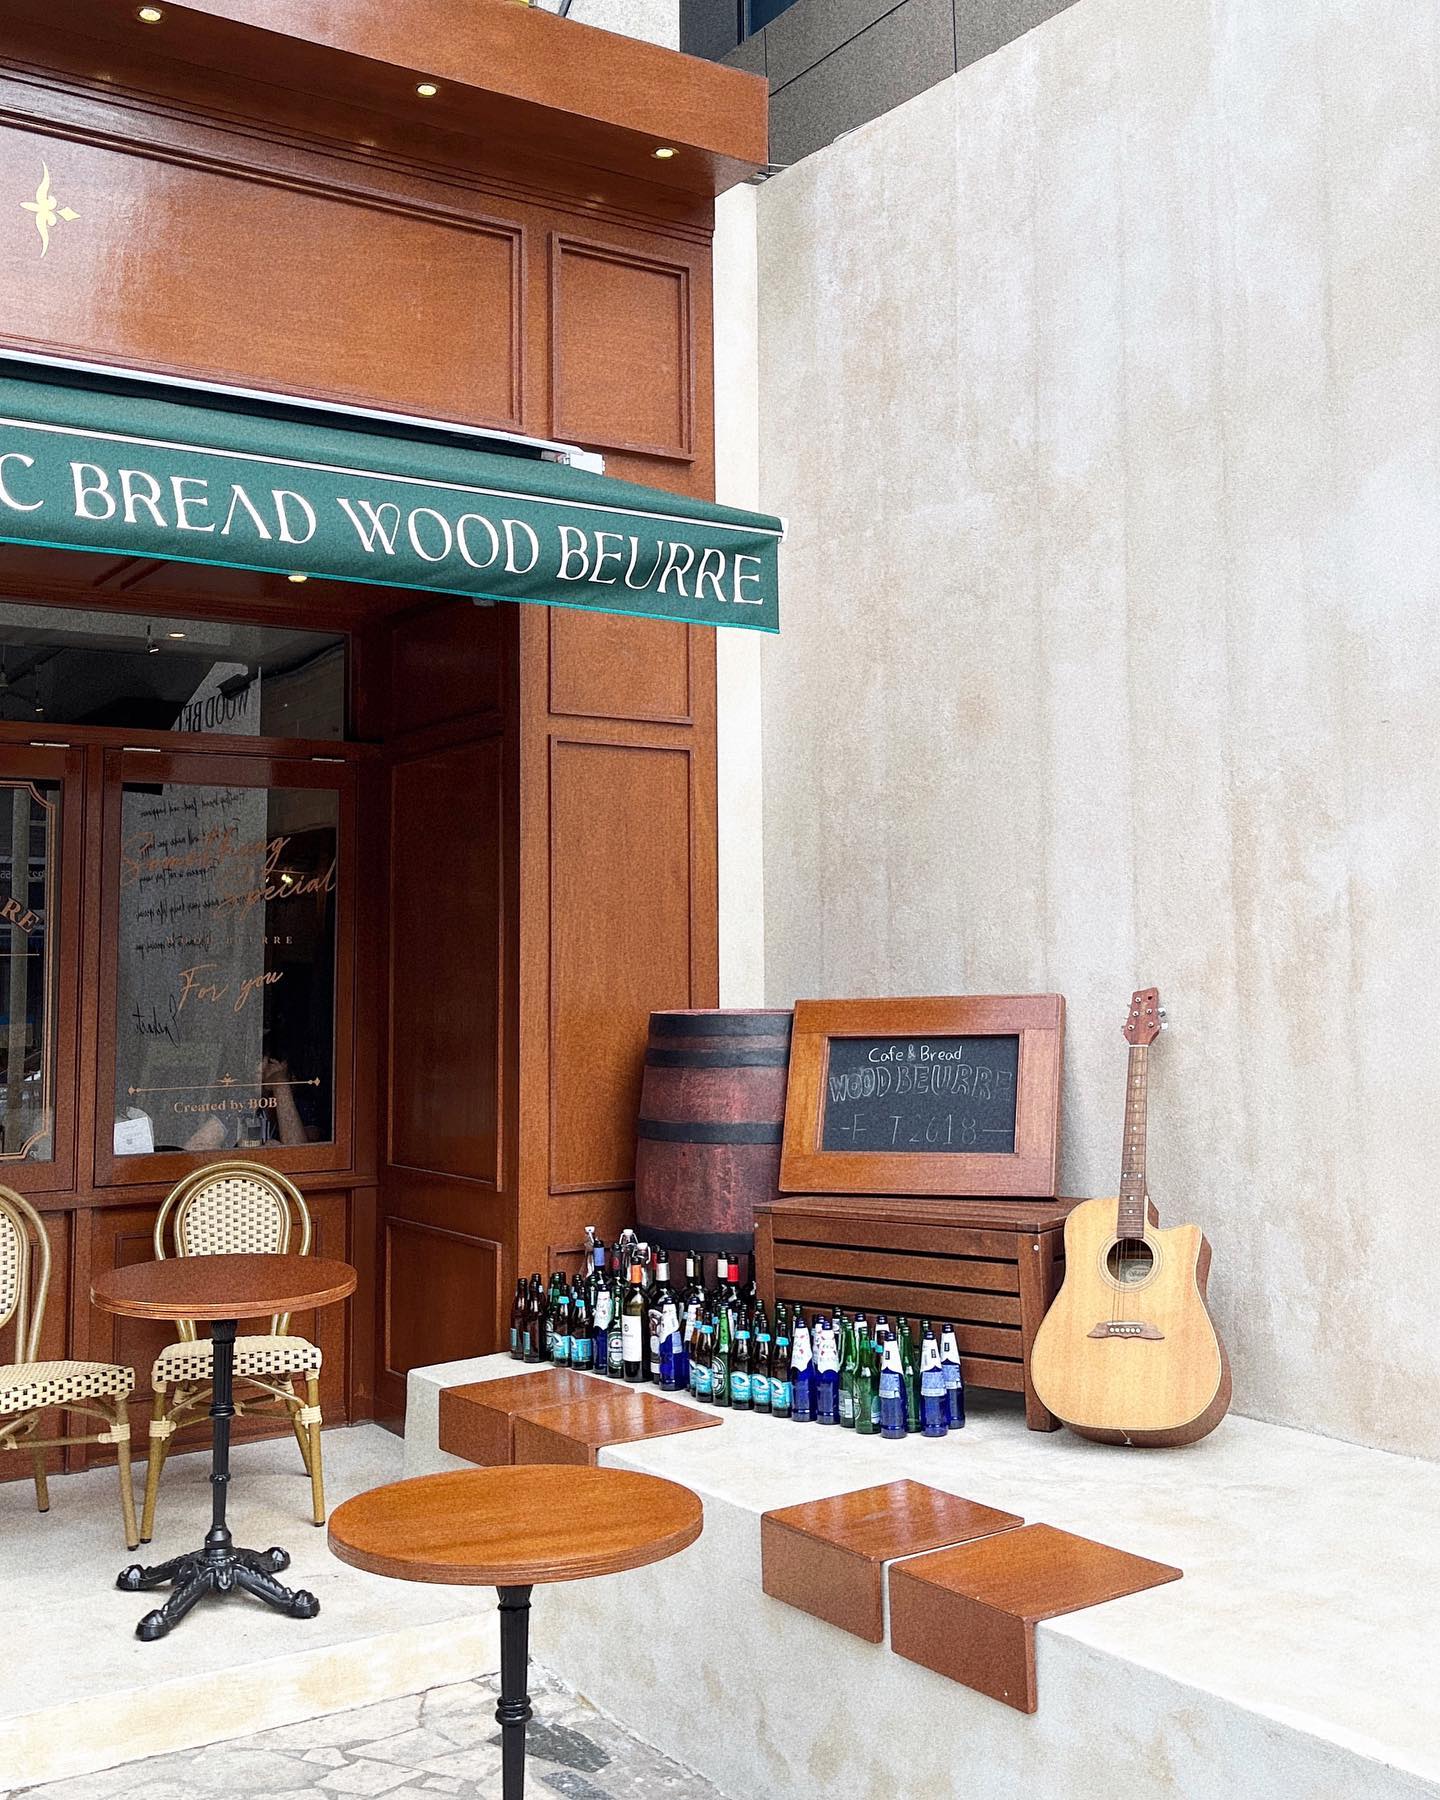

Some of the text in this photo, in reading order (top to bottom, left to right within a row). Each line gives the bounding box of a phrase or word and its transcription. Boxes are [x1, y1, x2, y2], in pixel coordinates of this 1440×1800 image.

[69, 462, 317, 544] BREAD
[336, 498, 539, 574] WOOD
[556, 525, 764, 605] BEURRE
[179, 963, 284, 1013] For you
[868, 1046, 904, 1063] Cafe
[920, 1045, 963, 1062] Bread
[174, 1097, 278, 1113] Created by BOB
